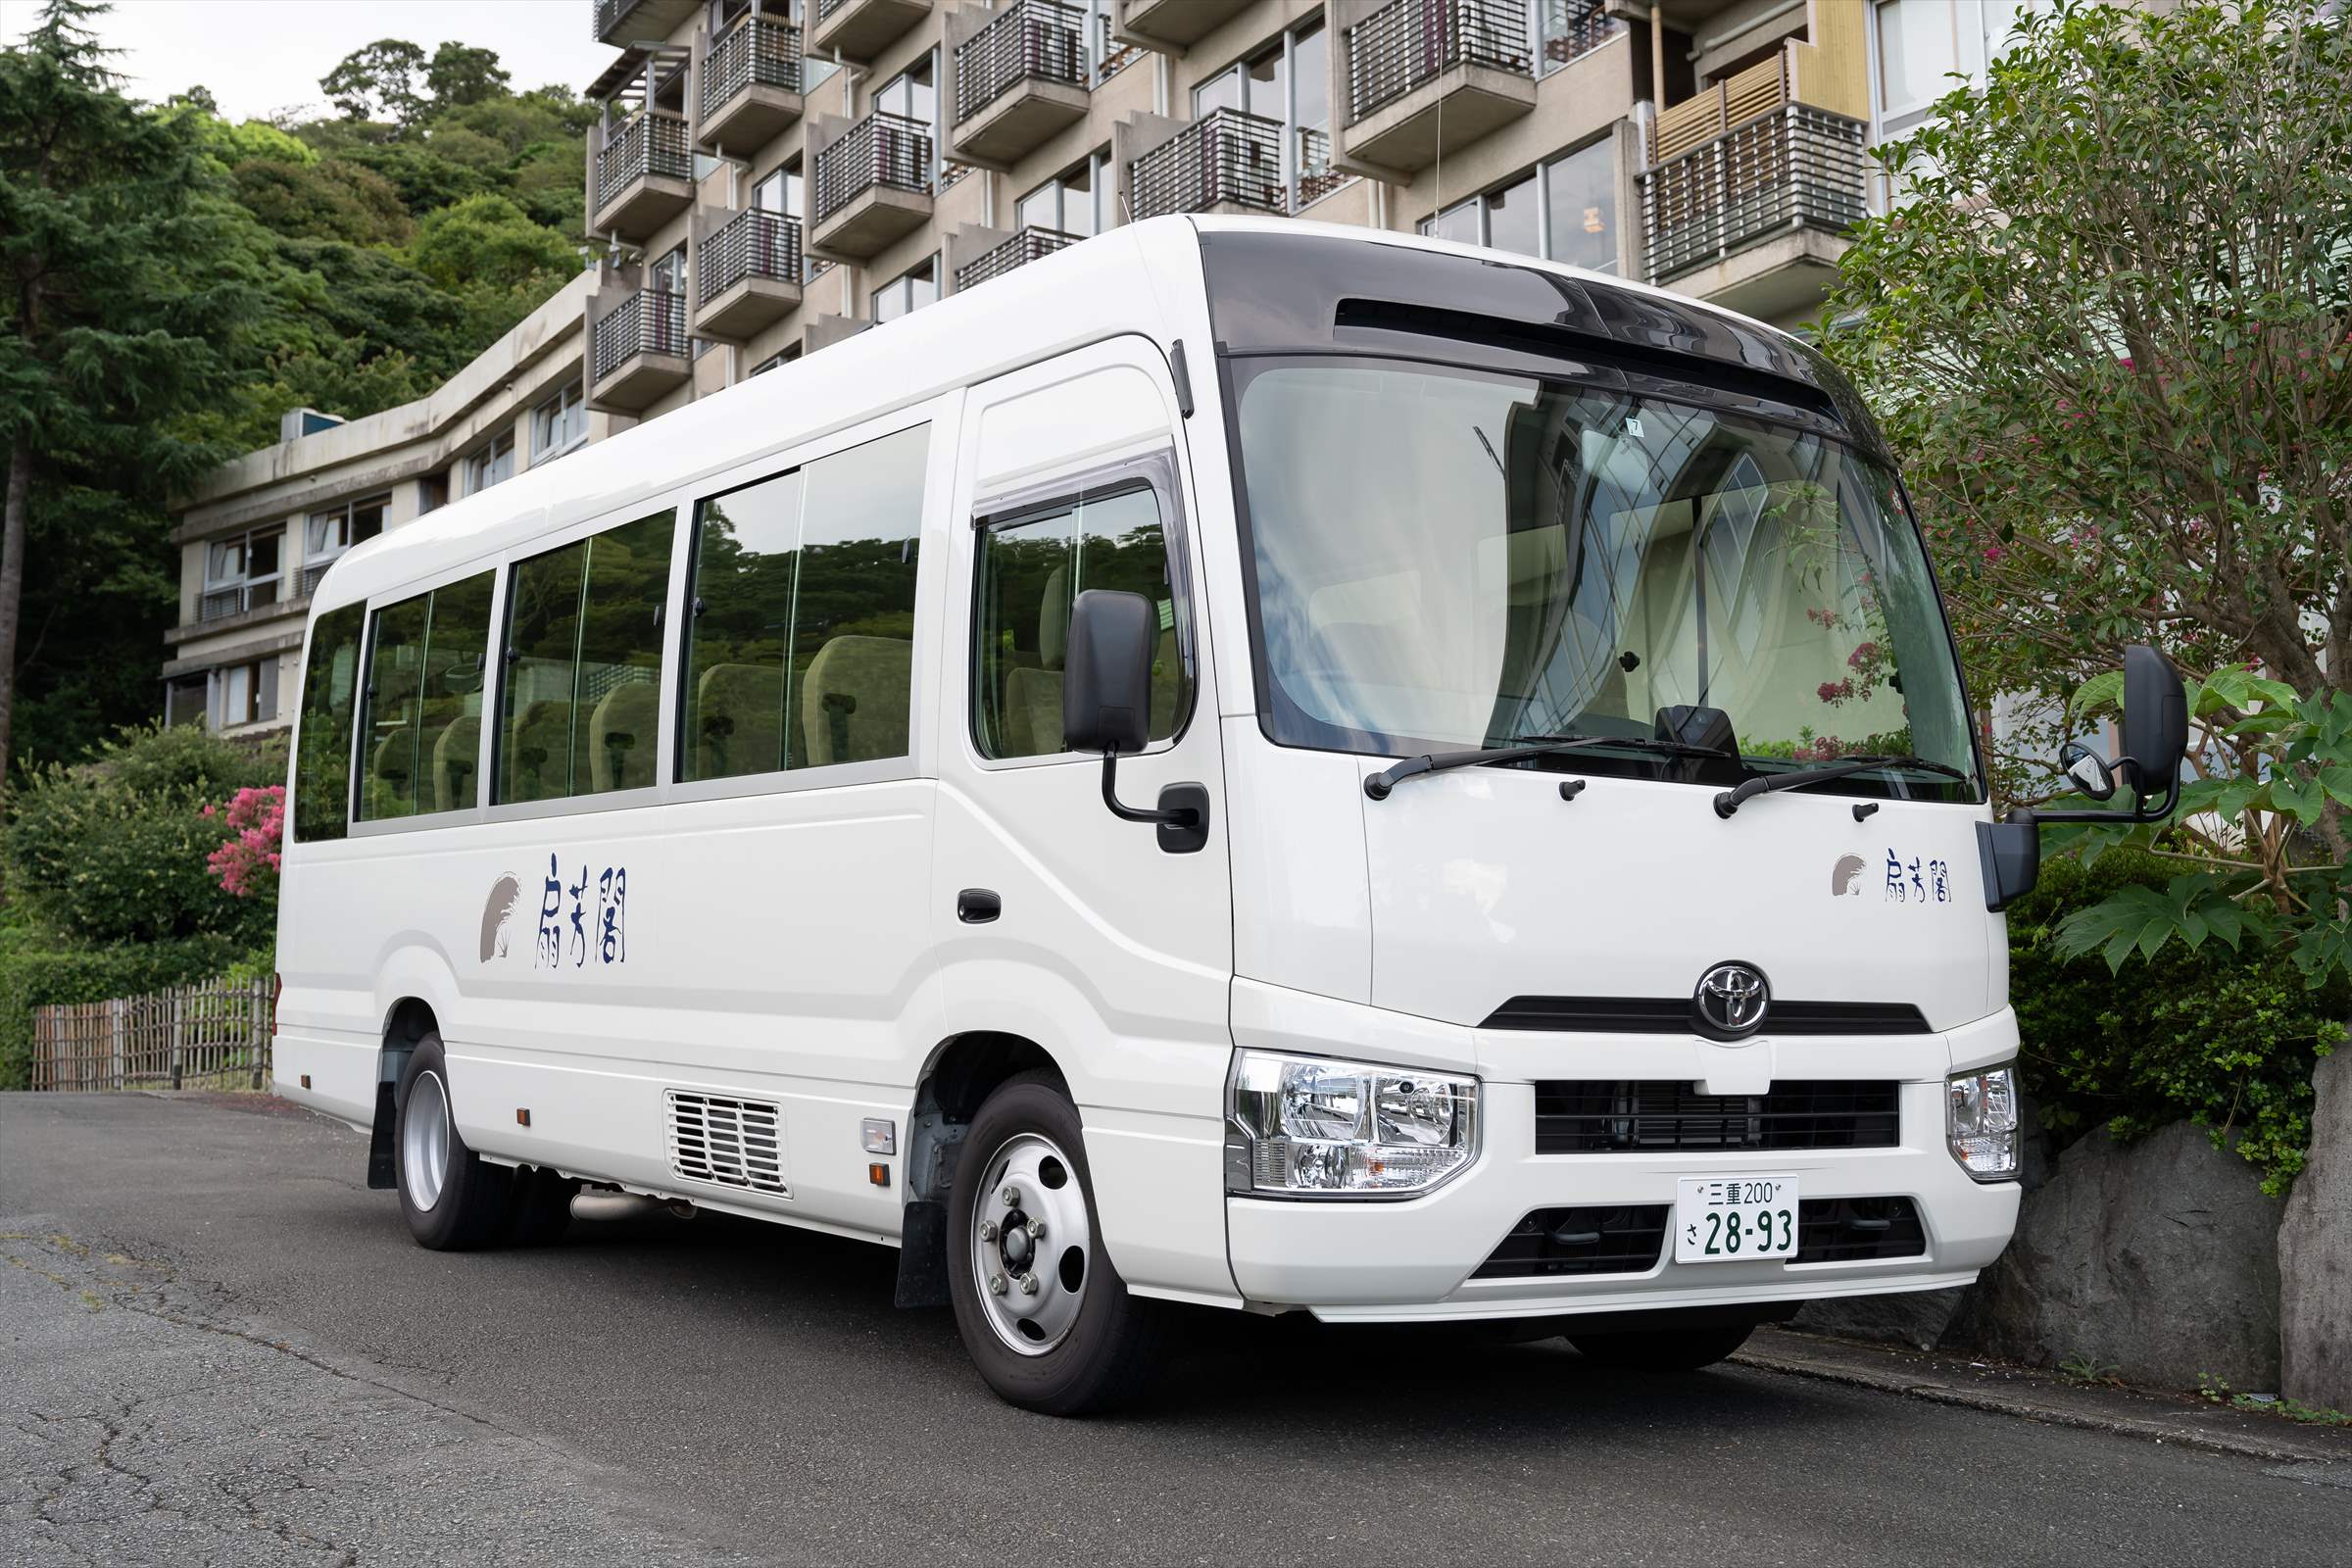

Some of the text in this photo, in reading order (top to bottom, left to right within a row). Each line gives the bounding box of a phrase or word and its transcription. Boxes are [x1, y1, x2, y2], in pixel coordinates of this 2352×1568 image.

[1885, 847, 1952, 903] 扇芳閣
[535, 852, 626, 968] 扇芳閣
[1708, 1182, 1773, 1205] 三重200
[1687, 1209, 1792, 1254] さ 28-93
